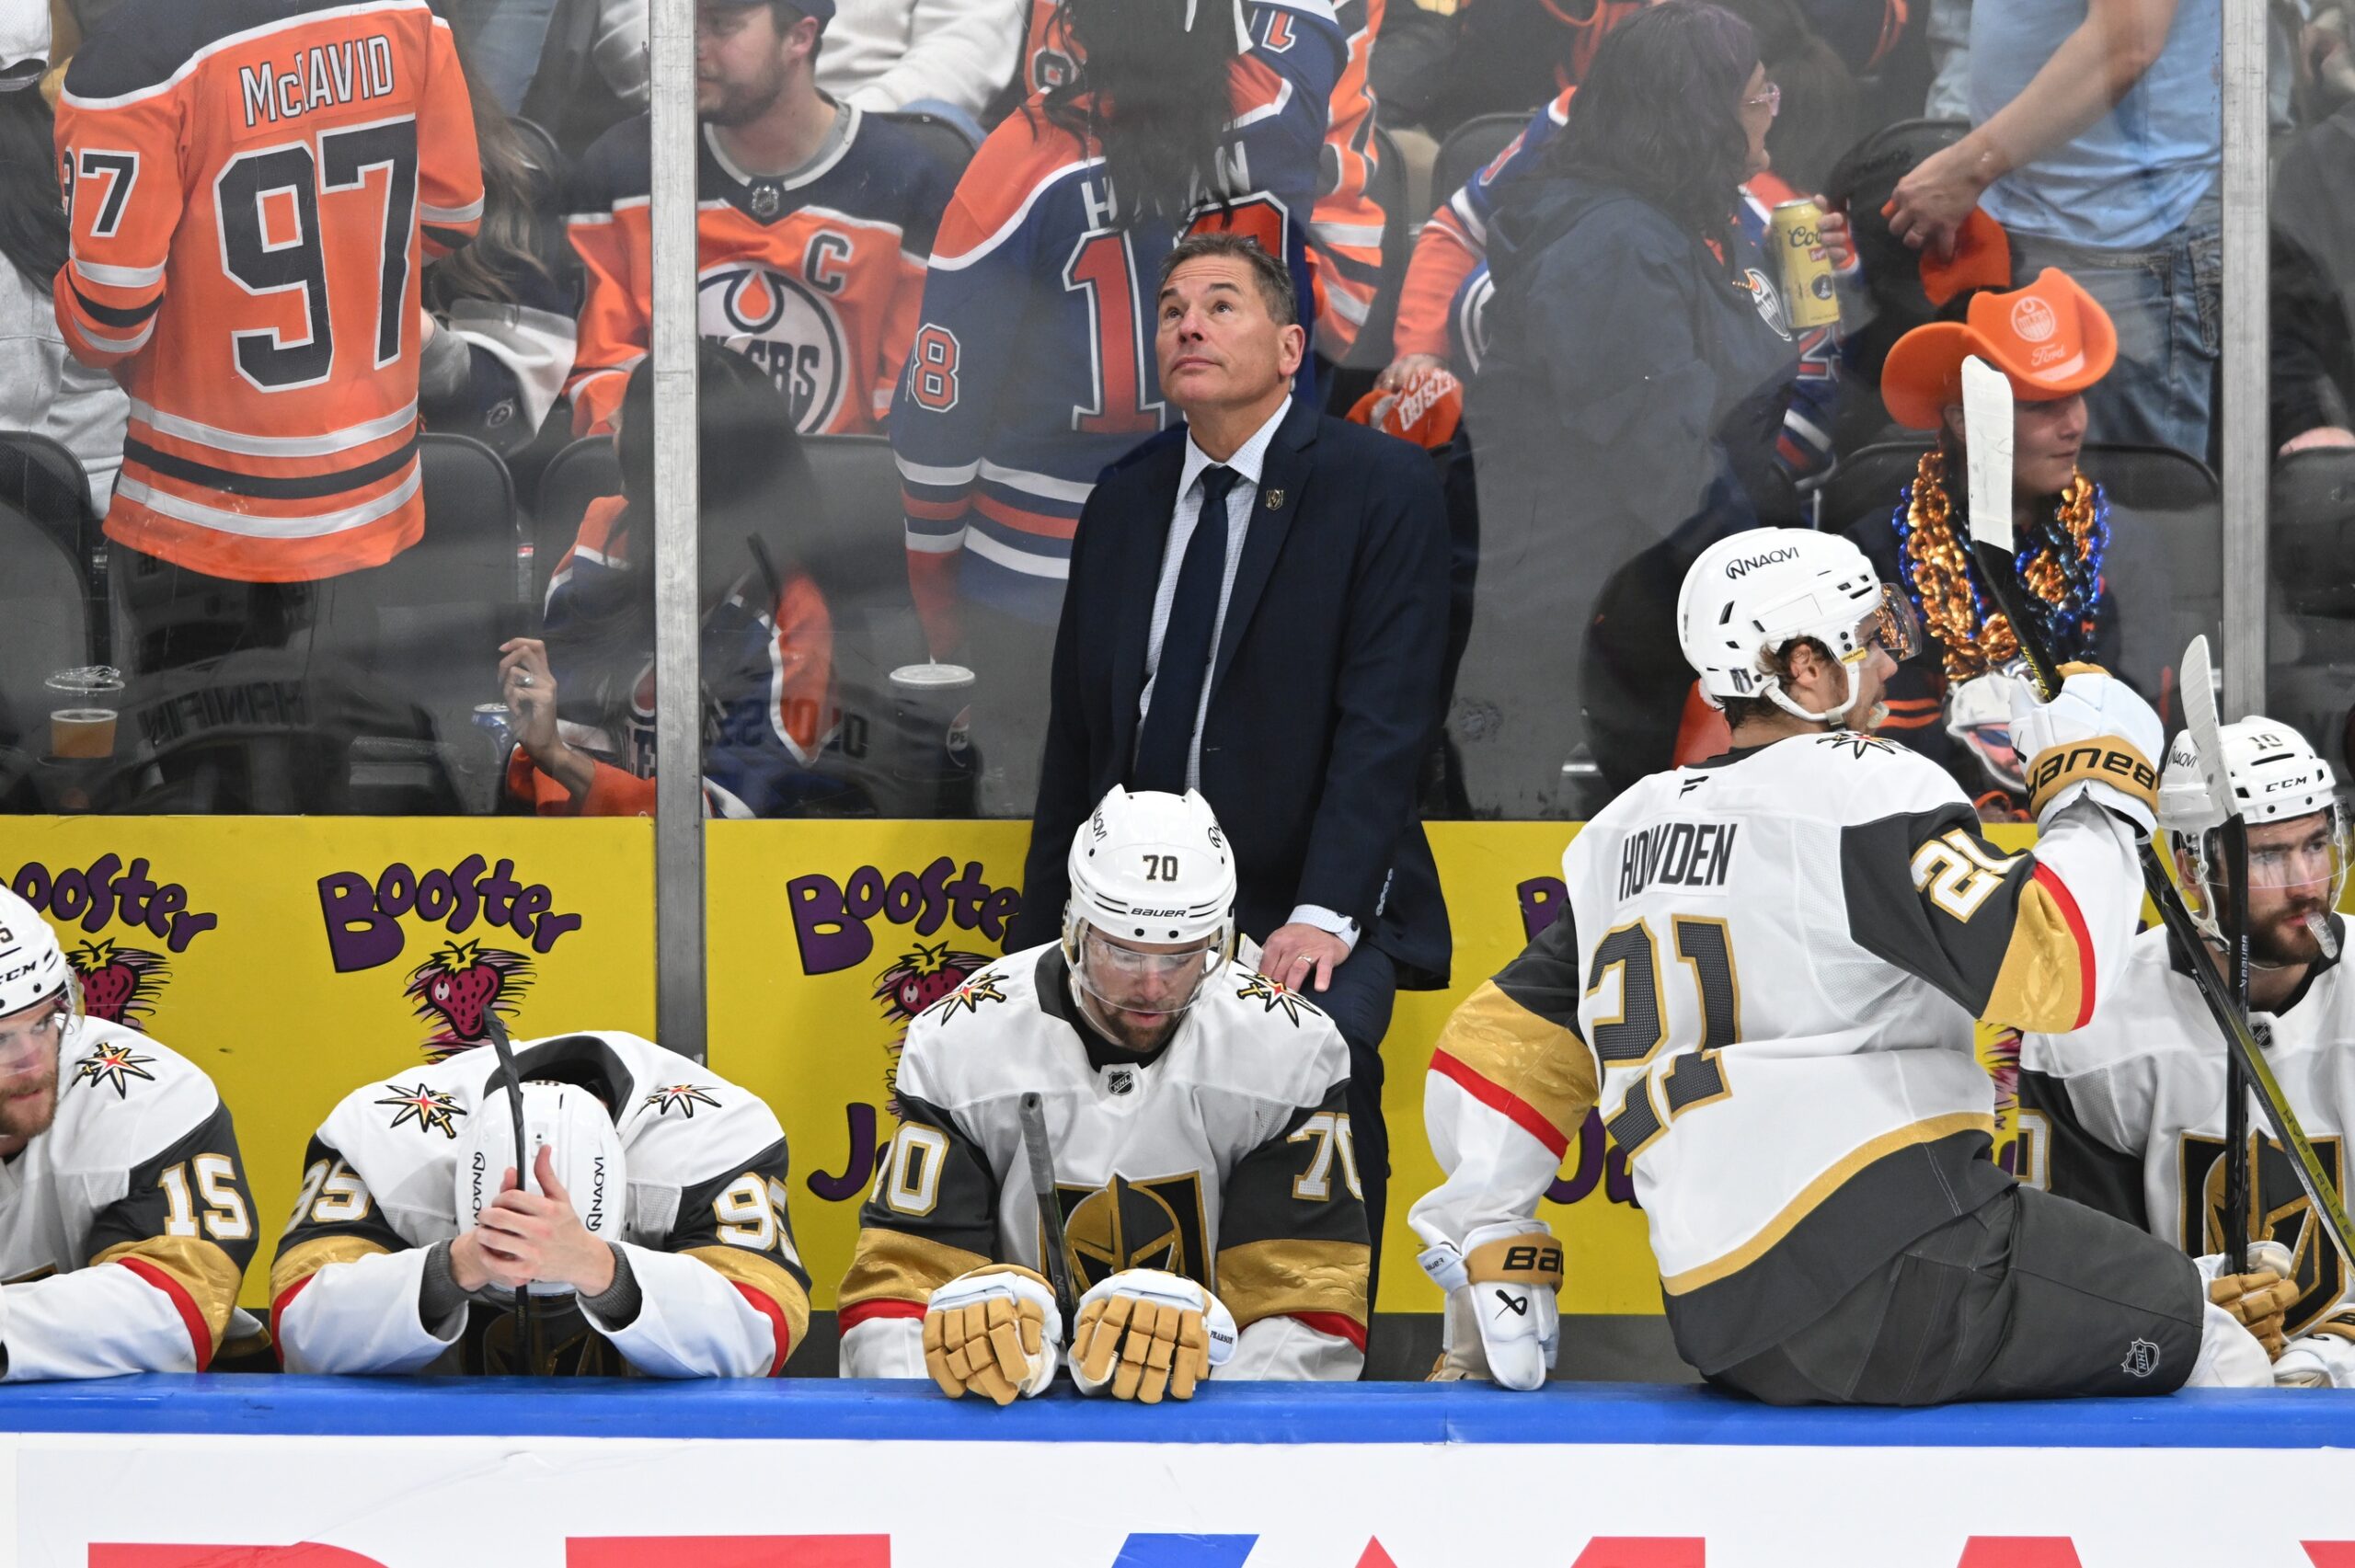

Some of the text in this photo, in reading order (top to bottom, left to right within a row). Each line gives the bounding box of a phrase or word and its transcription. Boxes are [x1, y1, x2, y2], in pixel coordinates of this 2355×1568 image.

[239, 34, 394, 127] McAVID
[213, 113, 418, 394] 97
[802, 233, 853, 295] C
[905, 323, 959, 413] 8
[2031, 343, 2065, 367] Ford
[1744, 546, 1799, 572] NAQVI
[2170, 751, 2199, 769] NAQVI
[2249, 733, 2283, 751] 10
[2026, 747, 2156, 807] BAUER
[2265, 776, 2308, 793] CCM
[1143, 854, 1178, 882] 70
[1619, 822, 1738, 902] HOWDEN
[1910, 828, 2028, 923] 21
[0, 853, 218, 954] ooster
[316, 853, 582, 974] Booster
[1131, 907, 1187, 918] BAUER
[0, 960, 37, 987] CM
[1584, 912, 1742, 1160] 21
[157, 1153, 252, 1241] 15
[592, 1156, 605, 1212] NAQVI
[868, 1120, 950, 1217] 0
[2282, 1109, 2352, 1238] HYPRLITE
[1502, 1246, 1564, 1276] BA
